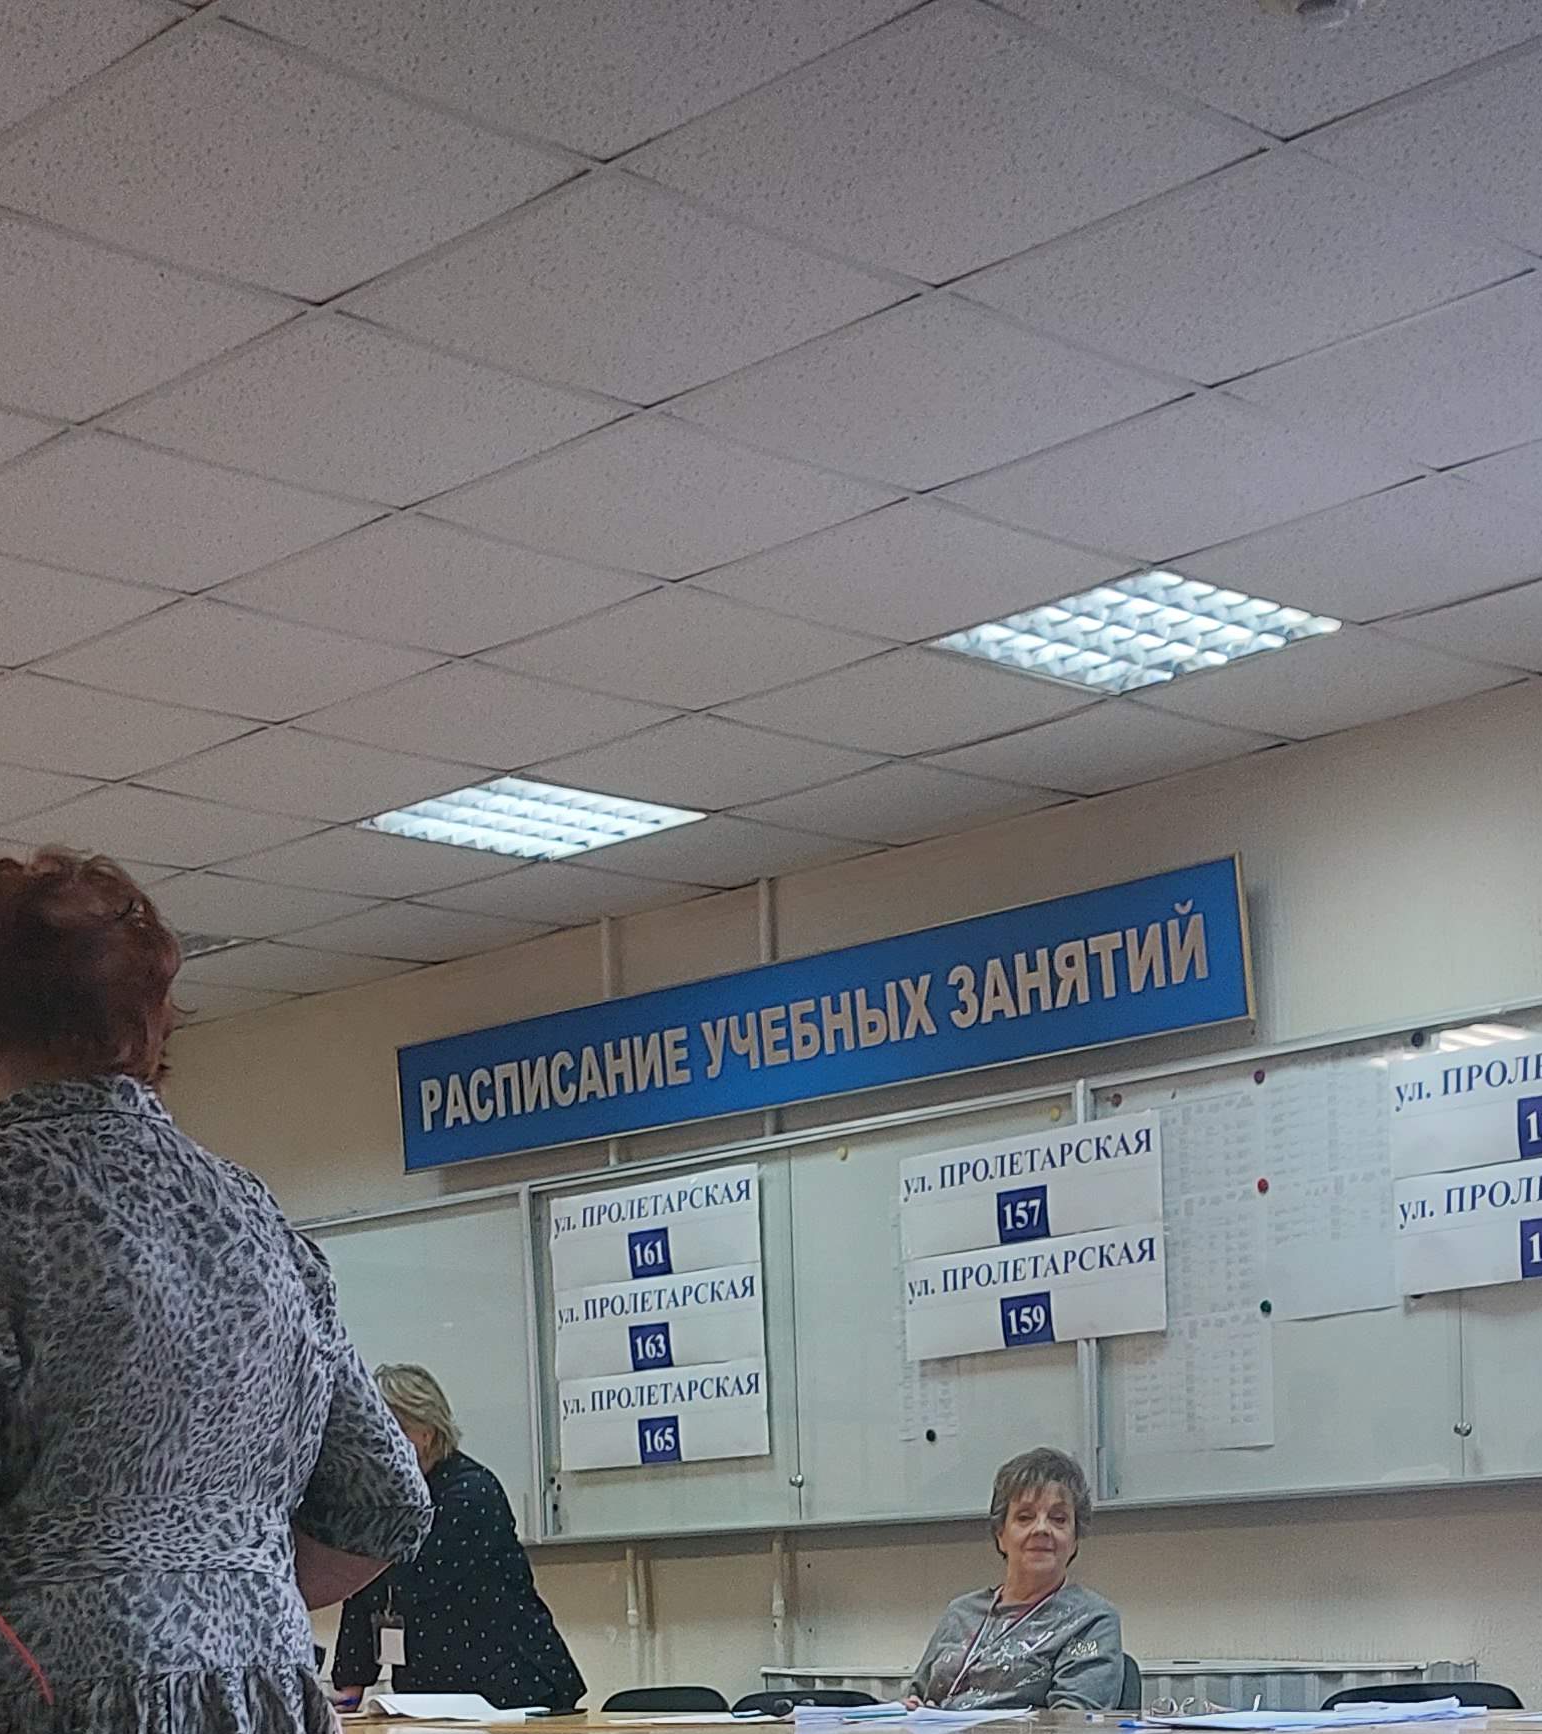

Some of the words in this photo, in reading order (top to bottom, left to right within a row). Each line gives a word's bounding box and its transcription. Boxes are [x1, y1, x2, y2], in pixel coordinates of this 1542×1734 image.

[420, 1026, 691, 1133] РАСПИСАНИЕ
[704, 974, 938, 1077] УЧЕБНЫХ
[948, 899, 1210, 1030] ЗАНЯТИЙ
[1395, 1078, 1433, 1111] ул.
[904, 1175, 933, 1199] ул.
[939, 1127, 1154, 1189] ПРОЛЕТАРСКАЯ
[553, 1215, 576, 1237] ул.
[581, 1178, 753, 1229] ПРОЛЕТАРСКАЯ
[1002, 1199, 1042, 1231] 157
[1398, 1198, 1436, 1230] ул.
[631, 1239, 667, 1269] 161
[907, 1277, 936, 1303] ул.
[941, 1235, 1157, 1293] ПРОЛЕТАРСКАЯ
[557, 1304, 580, 1328] ул.
[583, 1274, 756, 1323] ПРОЛЕТАРСКАЯ
[1006, 1306, 1047, 1336] 159
[634, 1335, 667, 1362] 163
[562, 1398, 586, 1421] ул.
[590, 1371, 762, 1412] ПРОЛЕТАРСКАЯ
[643, 1426, 676, 1454] 165
